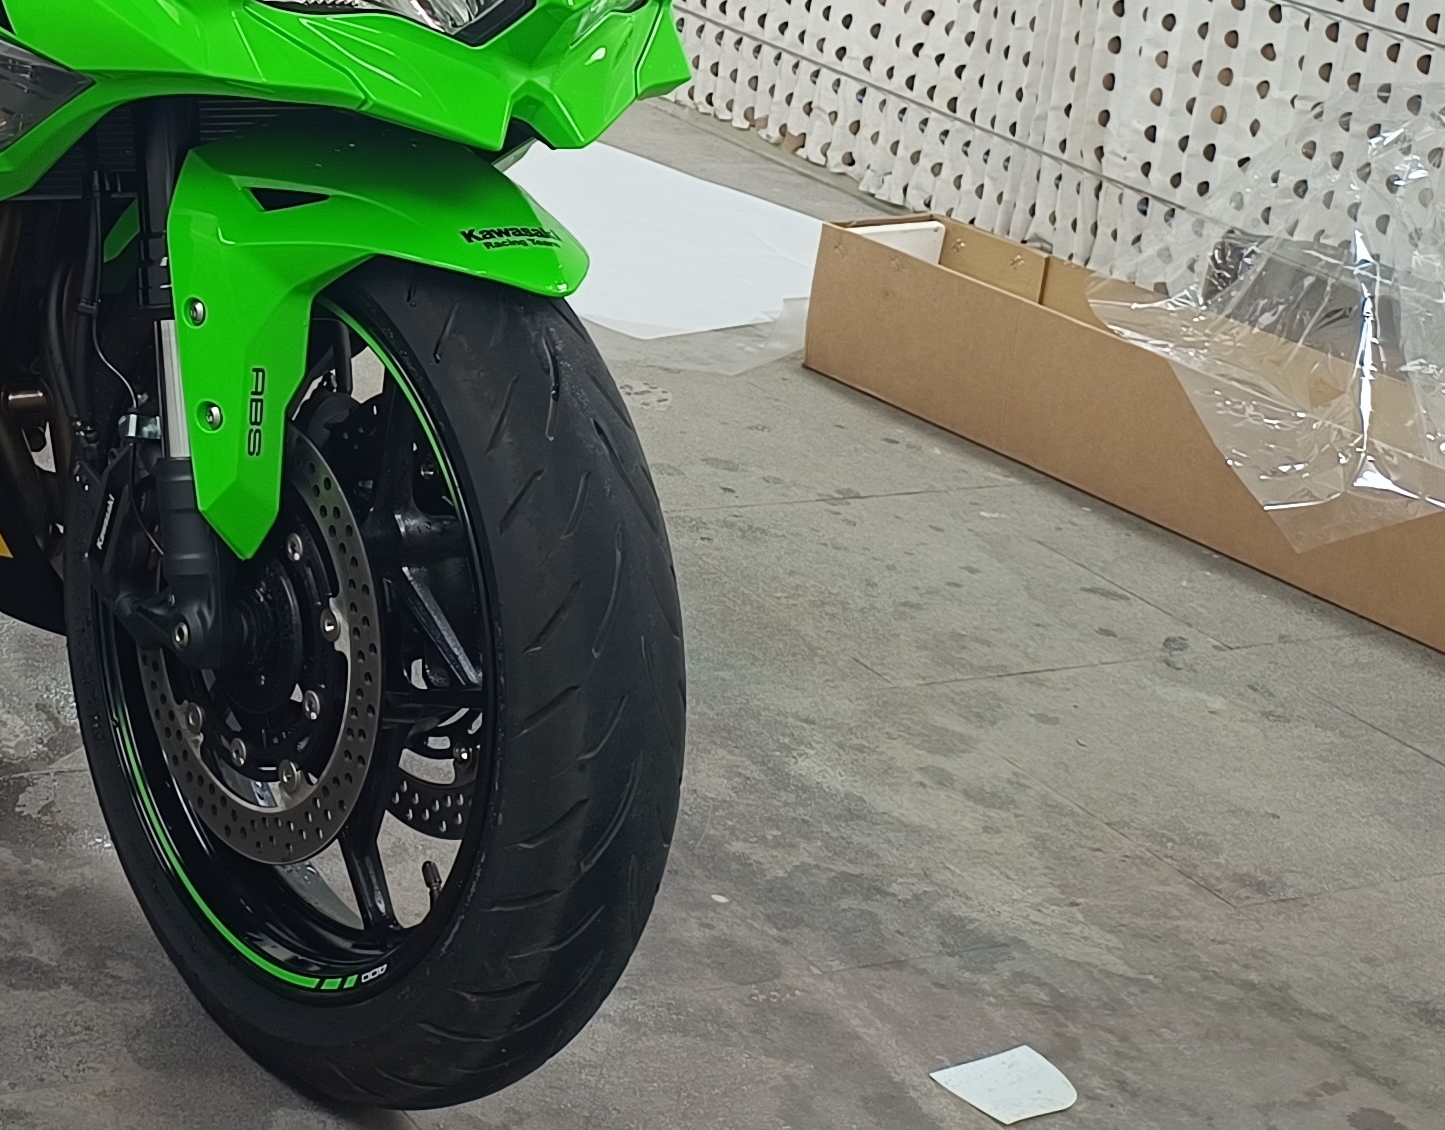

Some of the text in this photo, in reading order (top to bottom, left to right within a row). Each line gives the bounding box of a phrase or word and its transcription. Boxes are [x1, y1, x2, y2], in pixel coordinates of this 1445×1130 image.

[459, 225, 562, 244] Kawasaki
[483, 238, 562, 250] Racing Team
[247, 367, 266, 457] ABS
